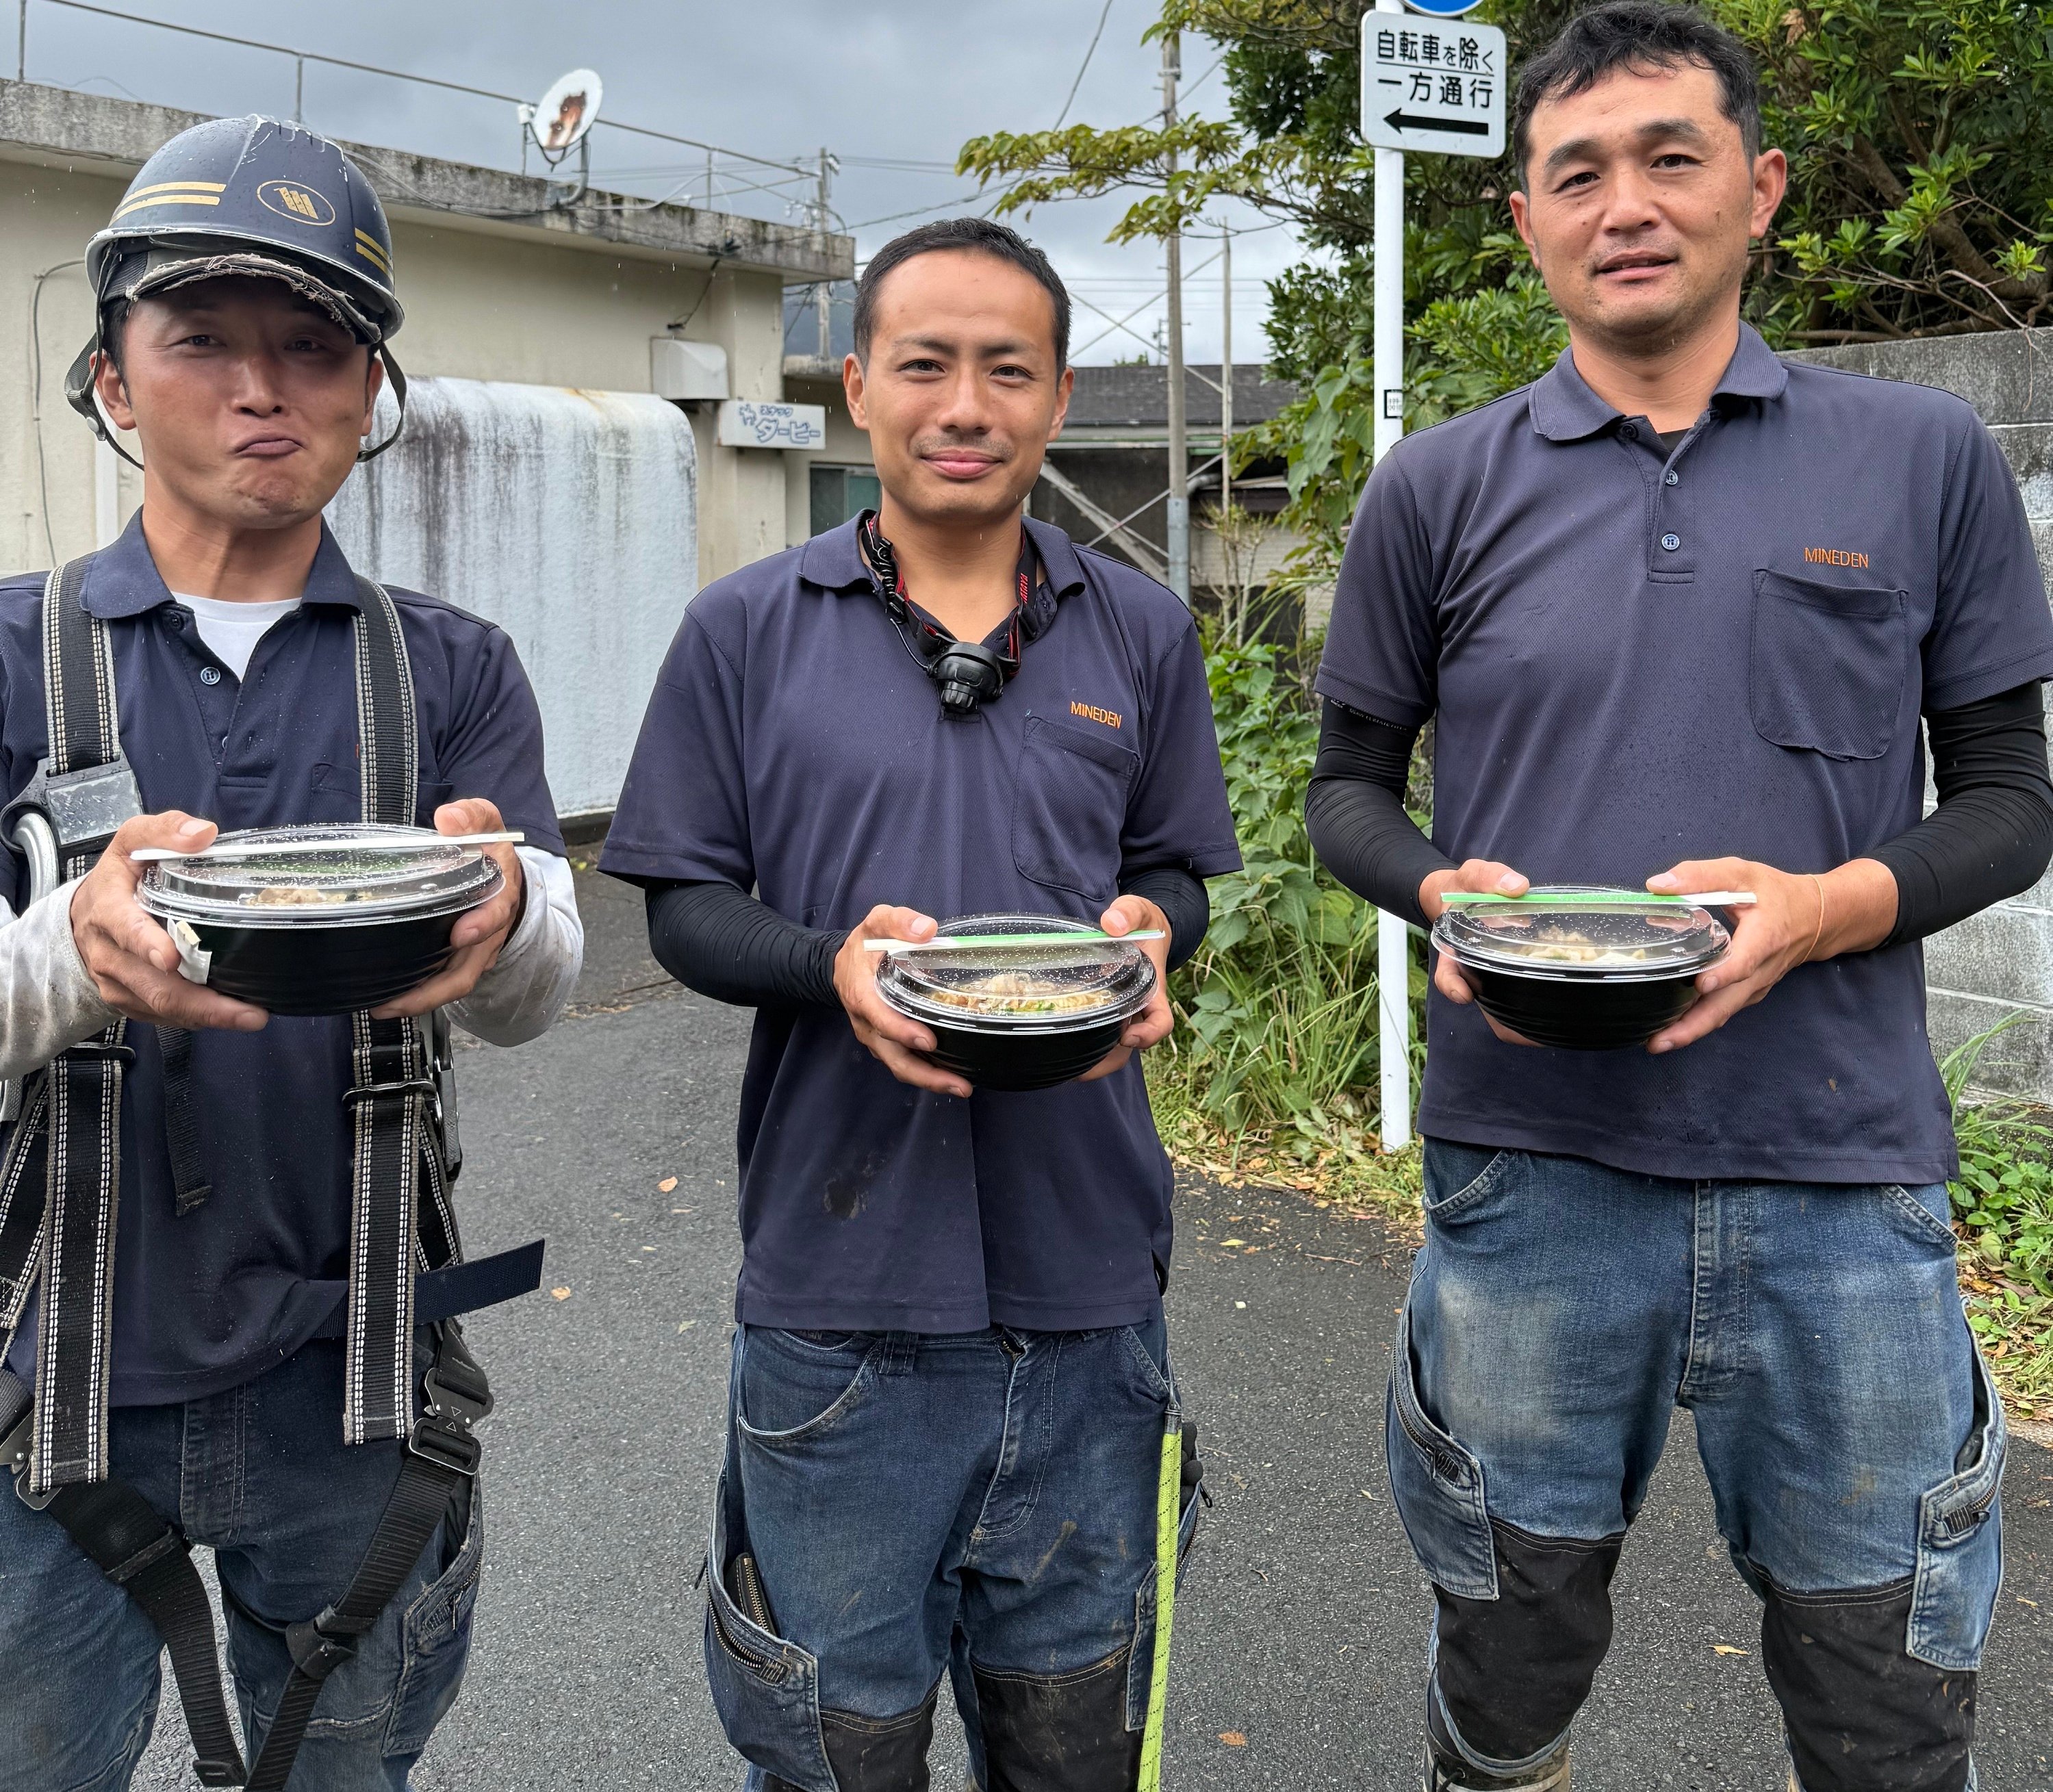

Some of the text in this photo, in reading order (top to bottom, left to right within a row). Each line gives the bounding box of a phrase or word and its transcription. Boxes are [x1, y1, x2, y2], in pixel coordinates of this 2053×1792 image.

[1378, 29, 1493, 71] 自転車を除く
[1378, 72, 1493, 108] 一方通行
[1805, 547, 1868, 569] MINEDEN
[1071, 701, 1122, 729] MINEDEN
